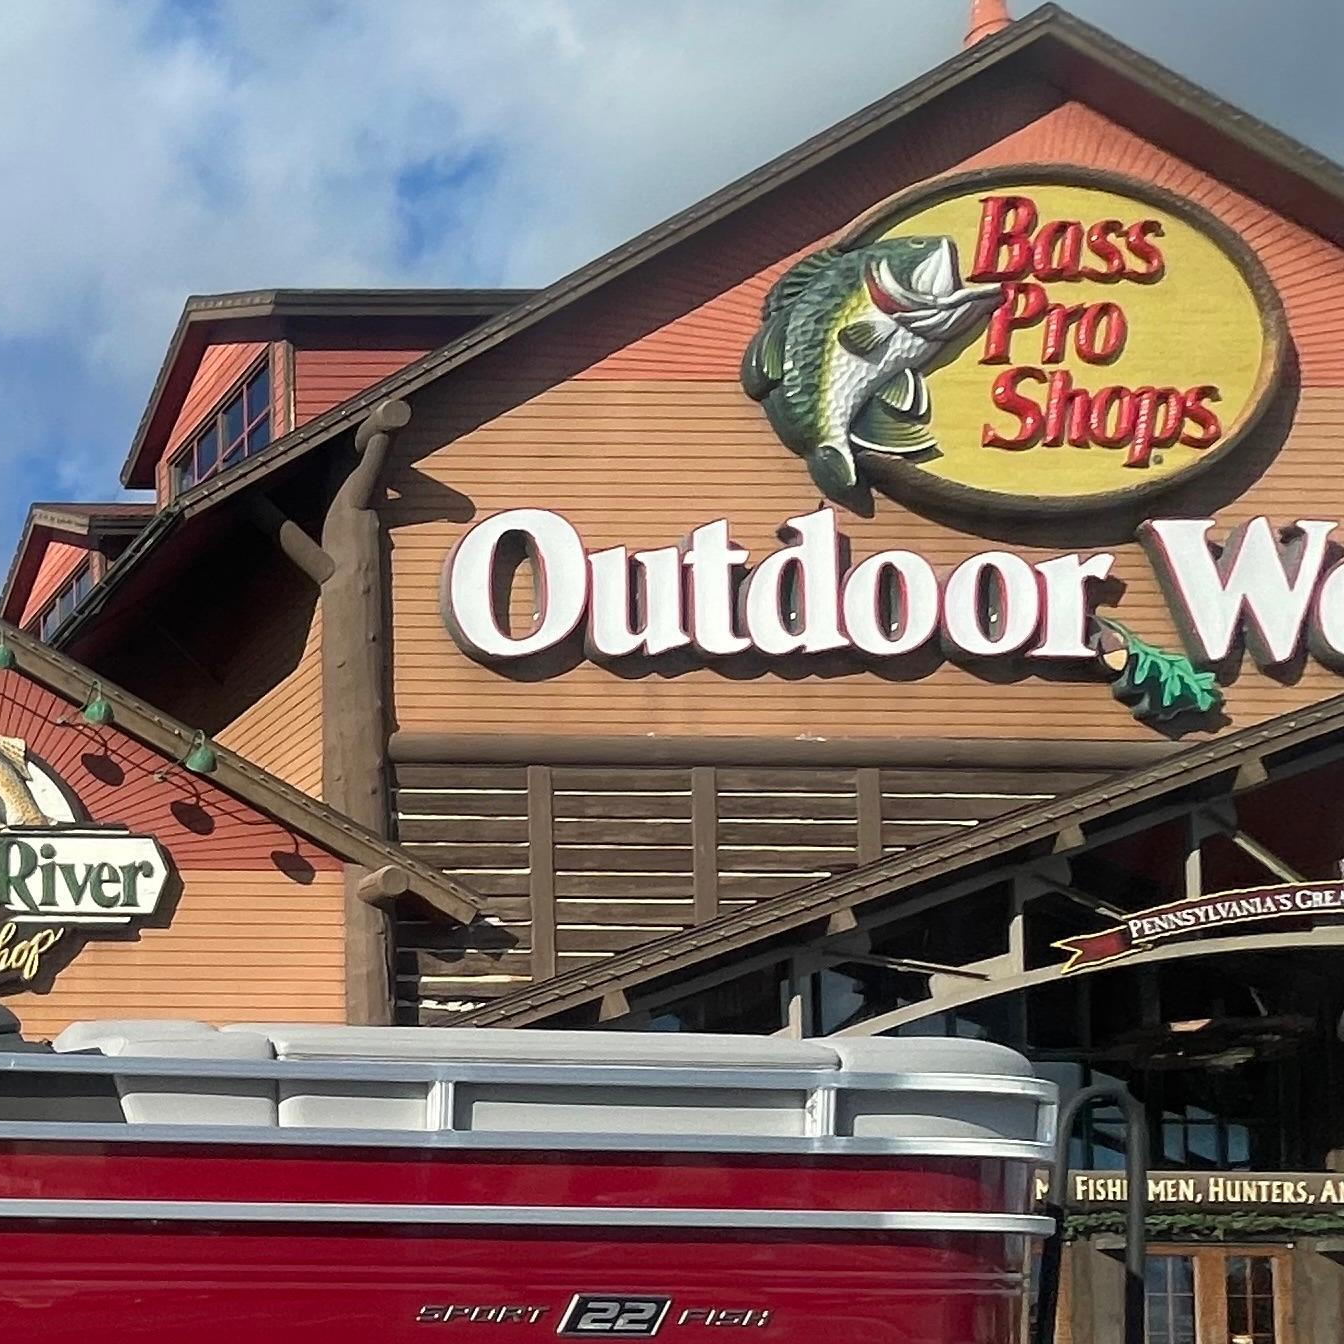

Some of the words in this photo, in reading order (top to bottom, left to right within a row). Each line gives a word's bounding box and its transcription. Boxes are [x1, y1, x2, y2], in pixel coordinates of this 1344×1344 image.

[966, 196, 1165, 285] Bass
[978, 282, 1128, 367] Pro
[982, 366, 1222, 468] Shops
[450, 506, 1115, 659] Outdoor
[1127, 893, 1294, 940] PENNSYLVANIA'S
[1208, 1177, 1316, 1205] HUNTERS,
[415, 1304, 552, 1324] SPORT
[576, 1301, 657, 1331] 22
[677, 1306, 776, 1327] FISH
